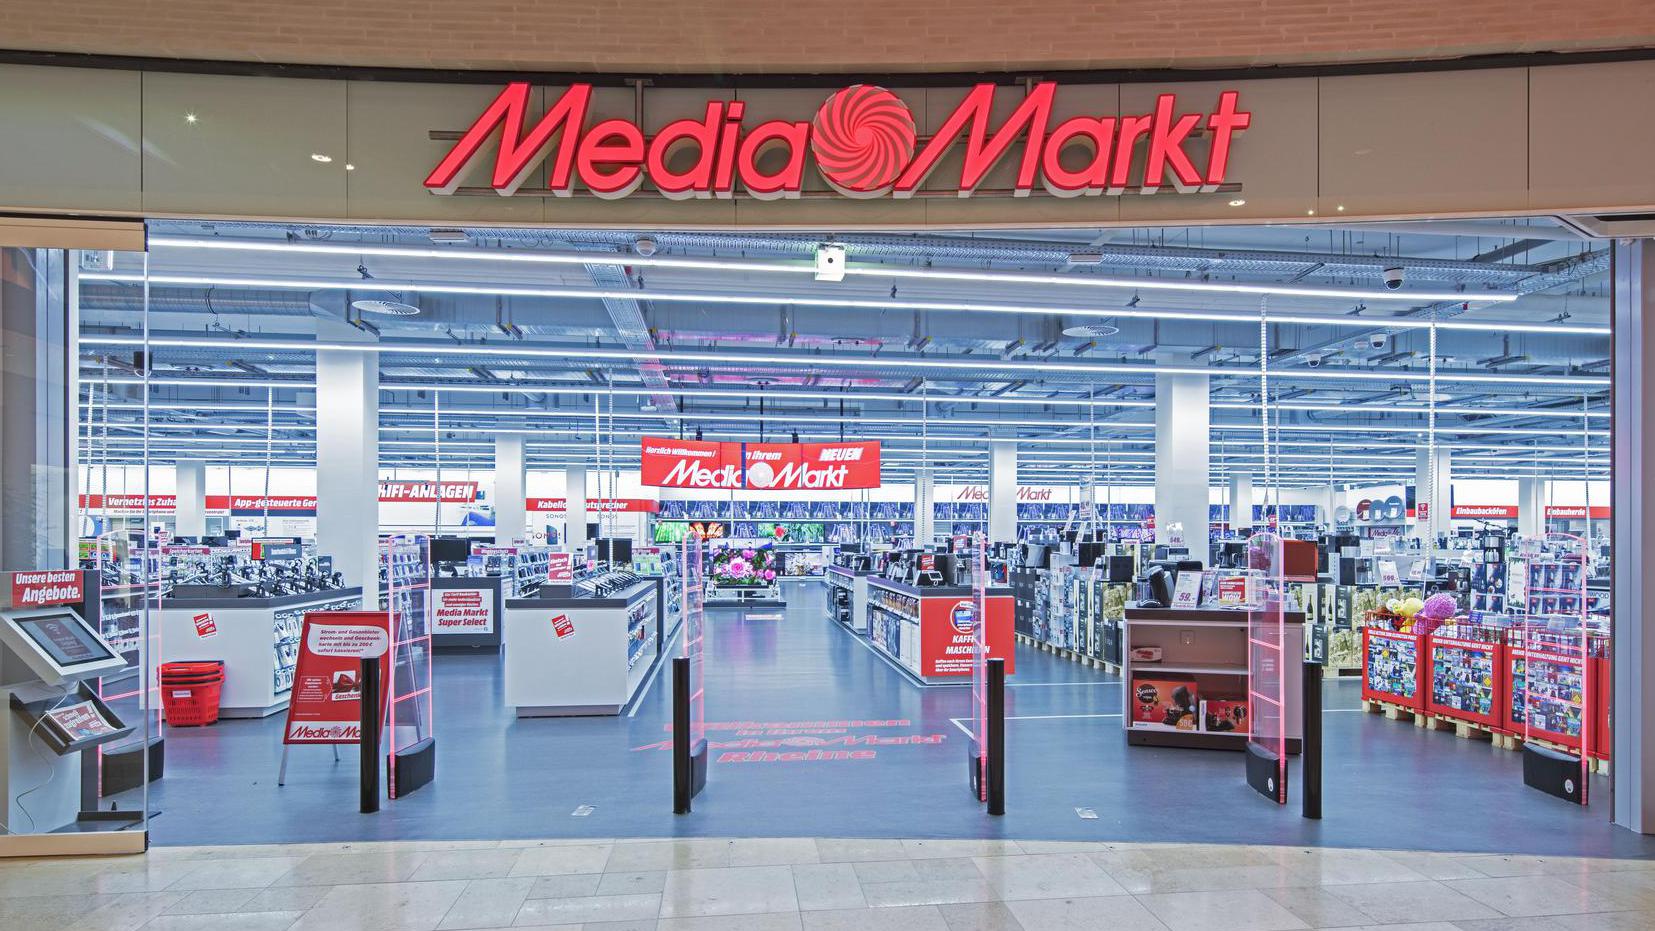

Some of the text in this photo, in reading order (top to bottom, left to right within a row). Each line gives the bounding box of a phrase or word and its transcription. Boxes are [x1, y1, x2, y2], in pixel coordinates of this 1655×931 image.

[423, 81, 1251, 198] Media Markt
[819, 447, 864, 461] NEUEN
[769, 462, 848, 488] Markt
[16, 571, 75, 585] Unsere besten
[22, 585, 81, 604] Angebote.
[437, 609, 488, 617] Media Markt
[438, 618, 487, 627] Super Select
[290, 726, 330, 738] Media
